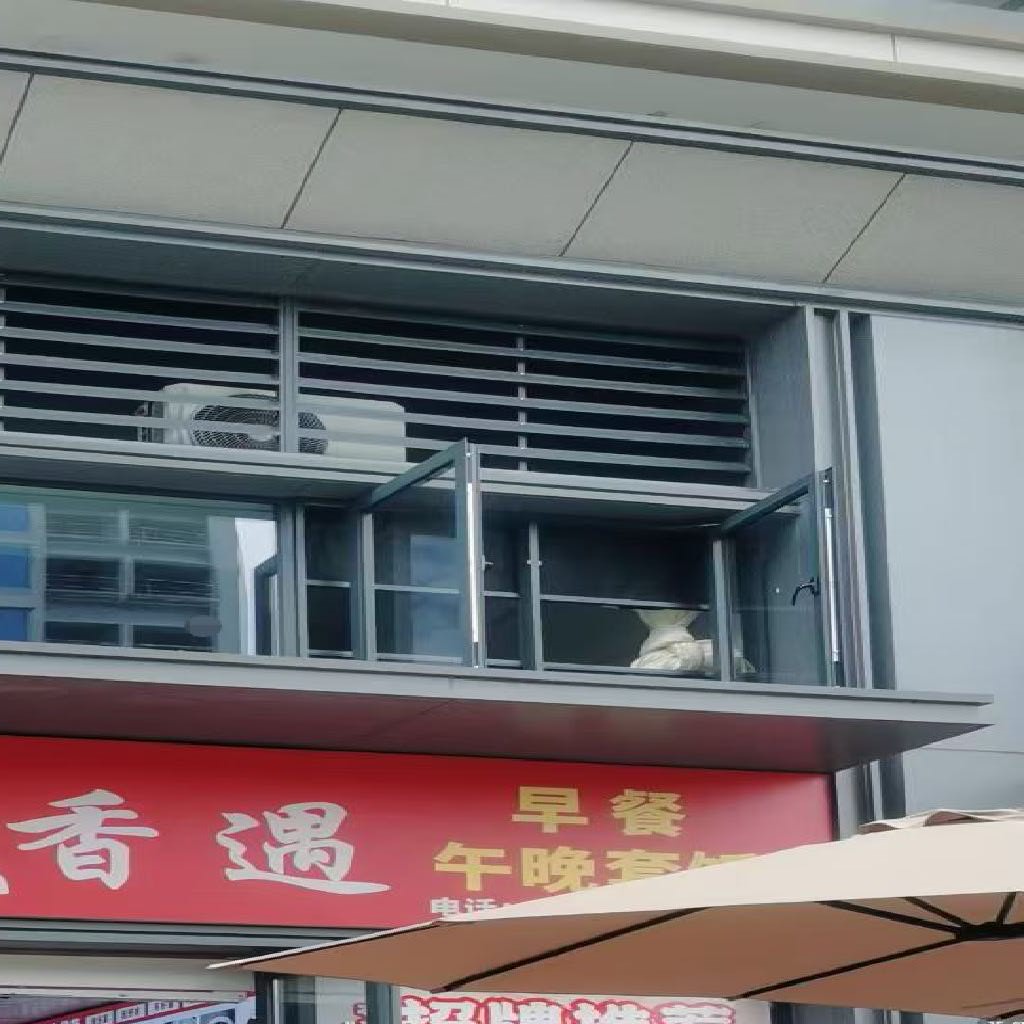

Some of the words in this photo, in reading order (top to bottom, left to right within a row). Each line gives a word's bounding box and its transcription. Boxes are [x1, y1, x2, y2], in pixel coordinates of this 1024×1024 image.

[512, 786, 687, 838] 早餐
[433, 841, 758, 892] 午晚套
